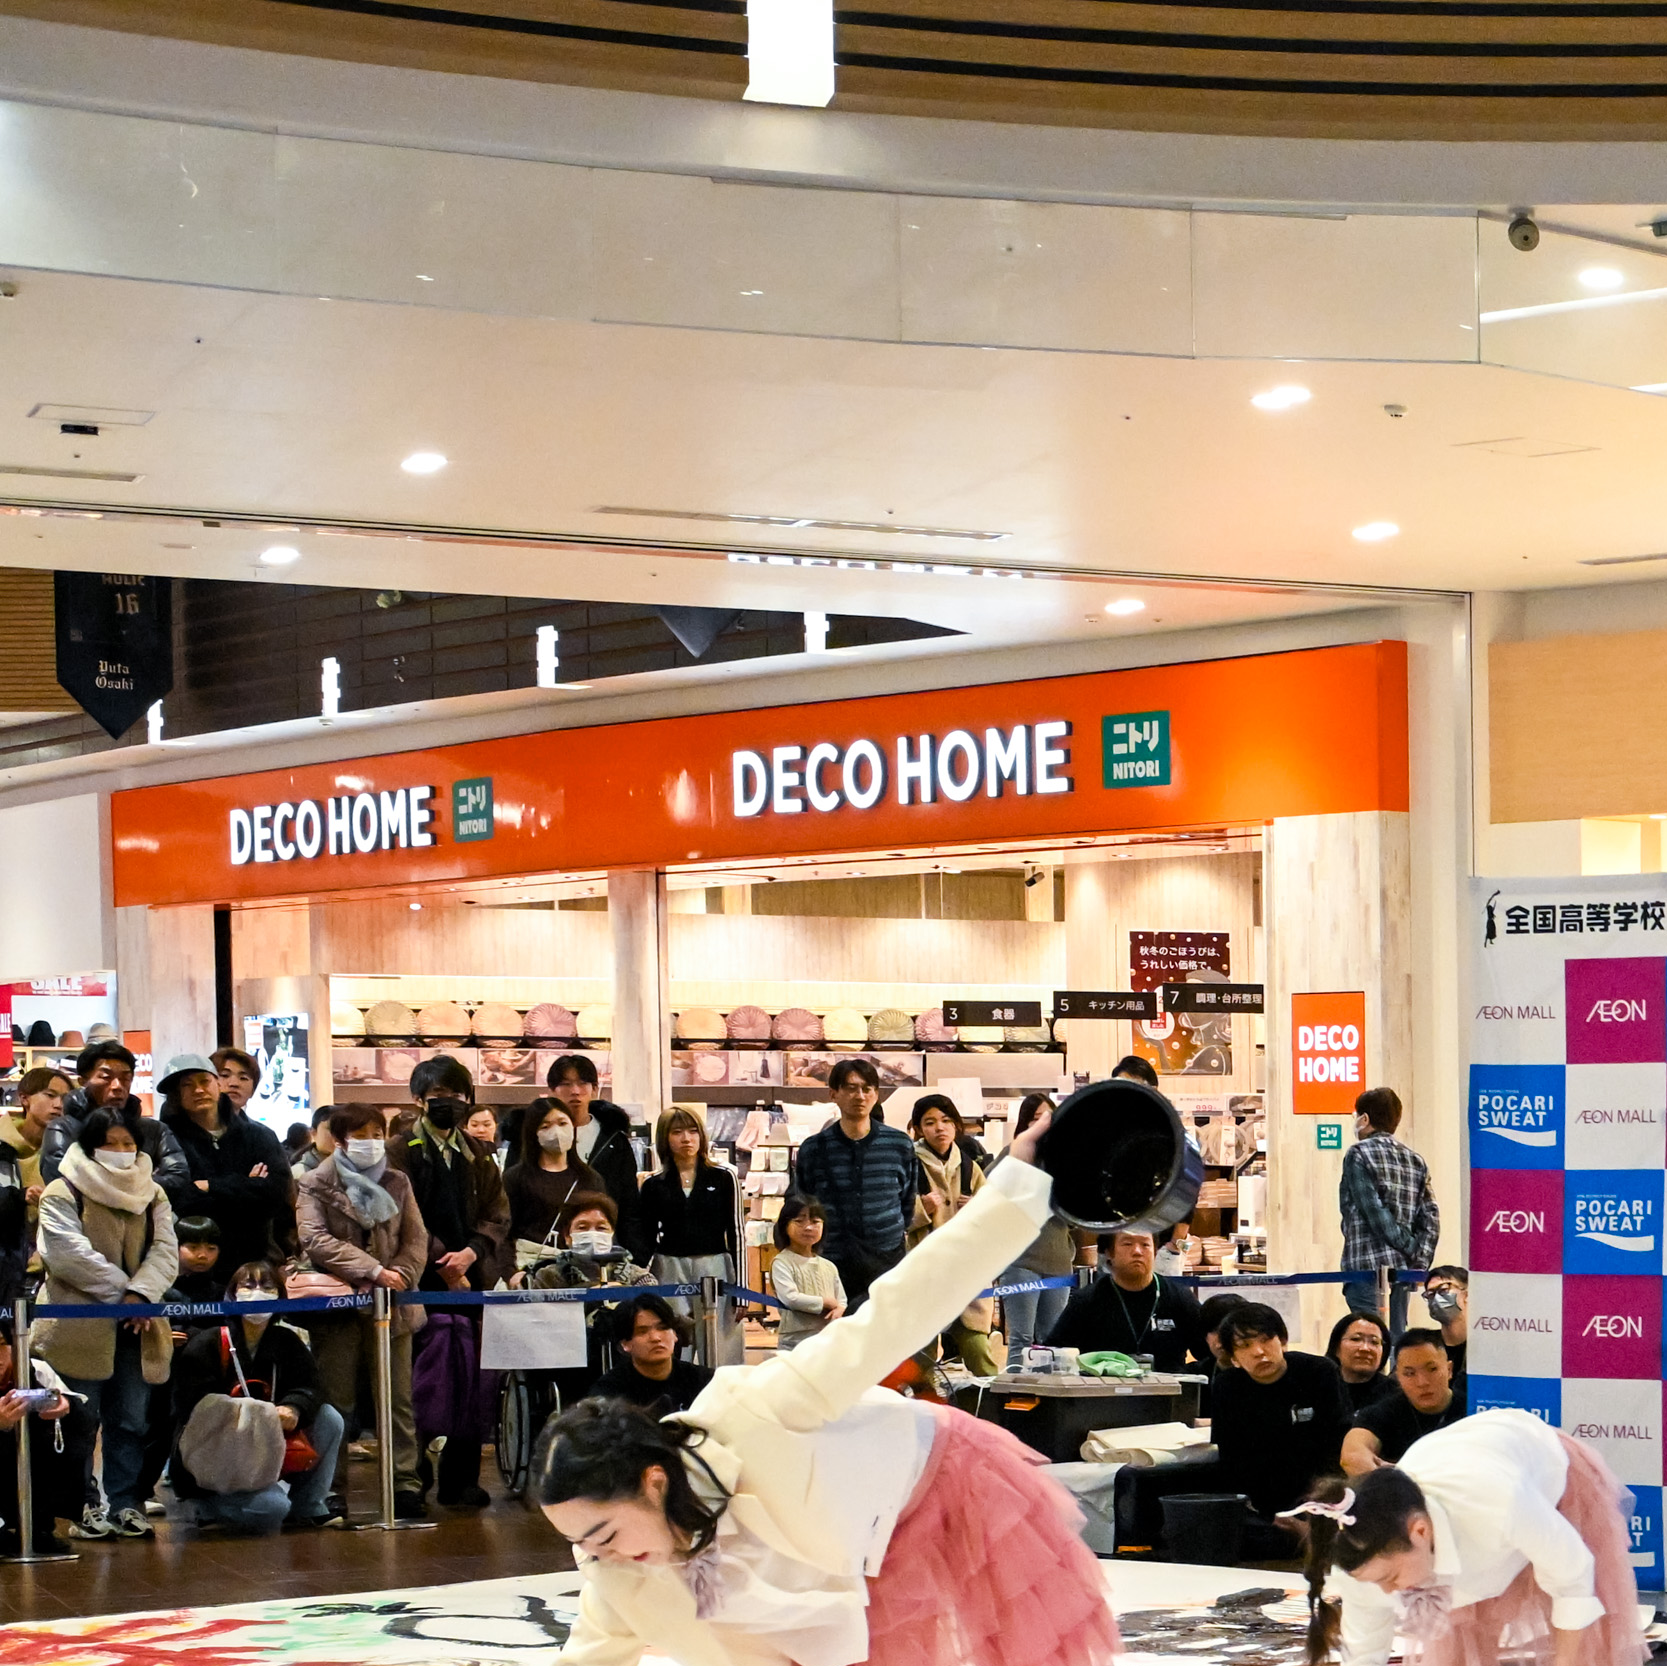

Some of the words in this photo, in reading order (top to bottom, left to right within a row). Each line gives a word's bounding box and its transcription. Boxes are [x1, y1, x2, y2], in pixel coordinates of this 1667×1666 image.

[1113, 720, 1158, 754] ニトリ
[733, 739, 884, 817] DECO
[897, 721, 1069, 805] HOME
[1113, 760, 1159, 780] NITORI
[459, 784, 486, 813] ニトリ
[230, 800, 322, 865] DECO
[328, 785, 434, 855] HOME
[459, 819, 487, 835] NITORI
[1506, 900, 1665, 934] 全国高等学校
[1140, 959, 1212, 971] うれしい価格で。
[1060, 999, 1069, 1011] 5
[1088, 1000, 1145, 1011] キッチン用品
[1170, 991, 1179, 1004] 7
[950, 1008, 957, 1020] 3
[992, 1008, 1015, 1020] 食器
[1517, 1006, 1555, 1020] MALL
[1299, 1025, 1359, 1050] DECO
[135, 1053, 152, 1071] ECO
[1299, 1057, 1359, 1082] HOME
[131, 1077, 152, 1094] OME
[1479, 1095, 1554, 1111] POCARI
[1479, 1111, 1546, 1126] SWEAT
[1617, 1109, 1656, 1124] MALL
[1576, 1200, 1652, 1216] POCARI
[1576, 1216, 1644, 1232] SWEAT
[194, 1303, 224, 1315] MALL
[358, 1295, 373, 1307] MA
[1514, 1318, 1553, 1332] MALL
[1613, 1425, 1653, 1440] MALL
